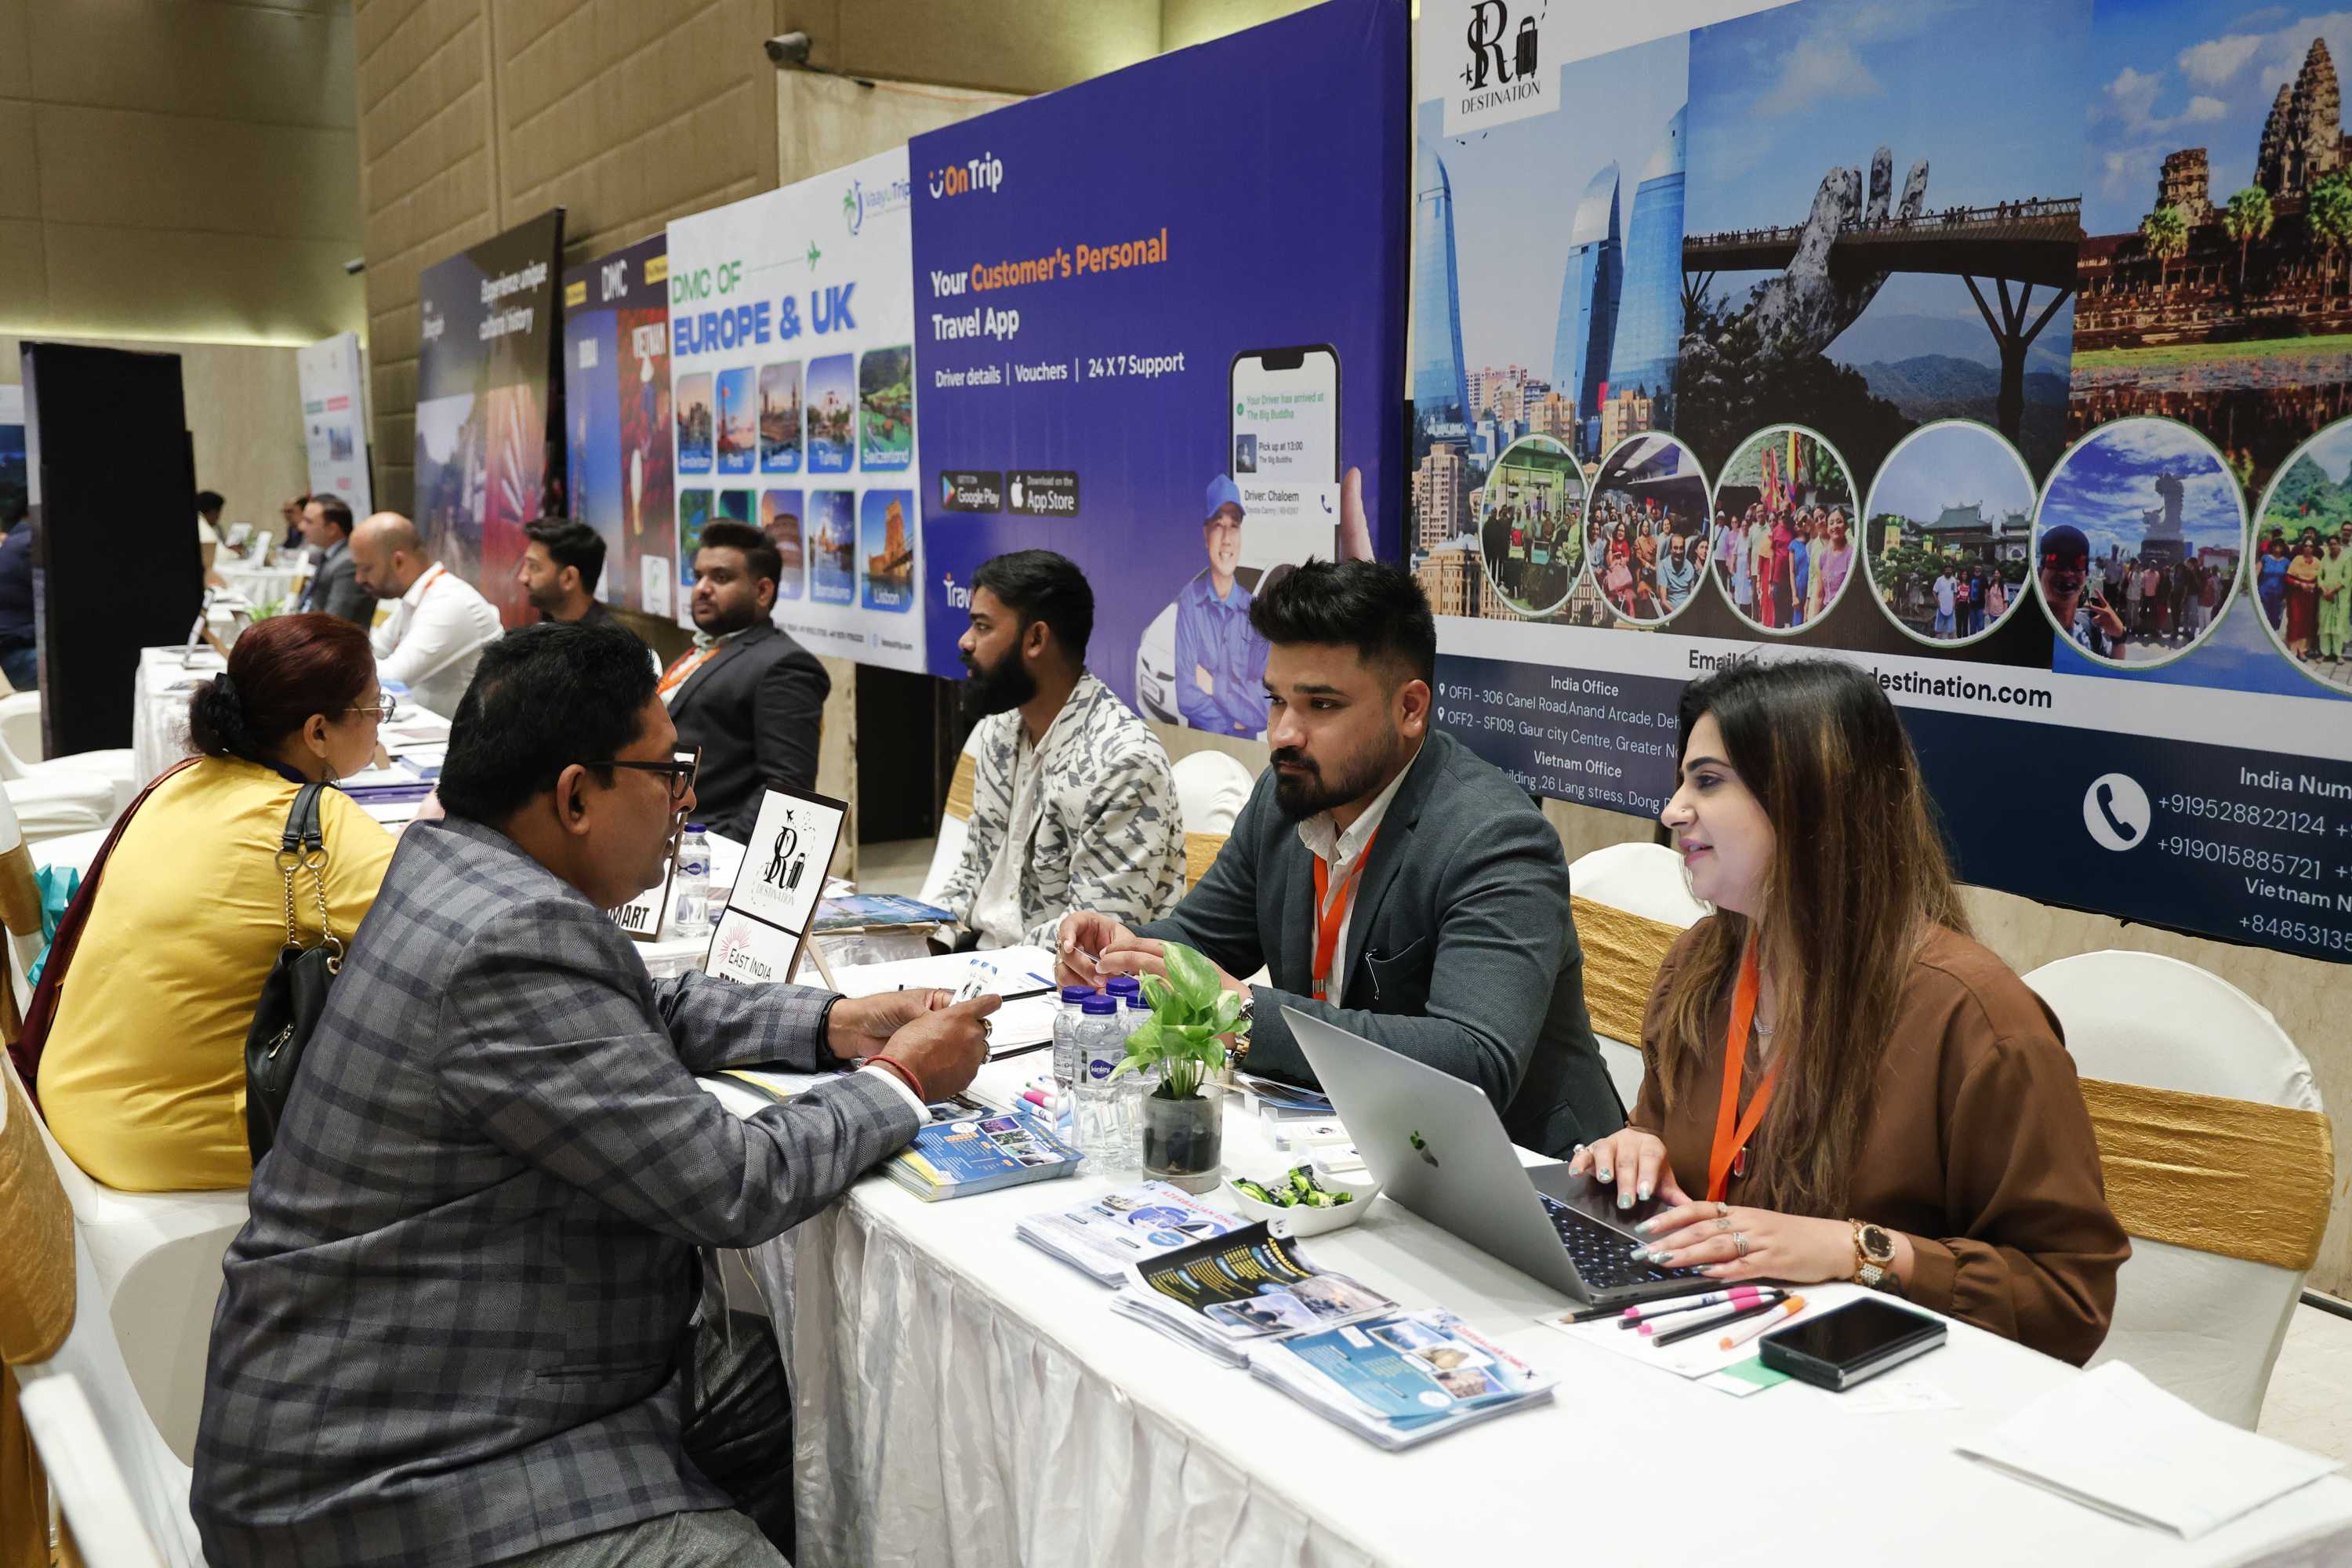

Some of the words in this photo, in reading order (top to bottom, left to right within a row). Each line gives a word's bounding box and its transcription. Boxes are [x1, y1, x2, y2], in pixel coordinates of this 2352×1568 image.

[1461, 81, 1541, 114] DESTINATION
[931, 270, 968, 298] Your
[971, 247, 1072, 292] Customer's
[1076, 227, 1167, 275] Personal
[672, 270, 712, 304] DMC
[717, 261, 742, 294] OF
[674, 301, 770, 356] EUROPE
[780, 296, 801, 340] &
[811, 281, 856, 335] UK
[932, 307, 980, 340] Travel
[984, 307, 1019, 341] App
[935, 368, 964, 388] Driver
[967, 365, 1001, 386] details
[1015, 361, 1067, 383] Vouchers
[1088, 358, 1105, 379] 24
[1106, 357, 1116, 376] X
[1118, 356, 1127, 375] 7
[1128, 352, 1185, 379] Support
[1247, 396, 1260, 405] Your
[1261, 394, 1279, 405] Driver
[1281, 394, 1292, 404] has
[1294, 393, 1316, 402] arrived
[1317, 392, 1324, 401] at
[1247, 410, 1258, 420] The
[1259, 410, 1269, 421] Big
[1271, 409, 1294, 419] Buddha
[818, 449, 843, 470] Turkey
[863, 447, 909, 465] Switzerland
[1258, 441, 1270, 451] Pick
[1272, 444, 1278, 452] up
[1279, 442, 1286, 451] at
[956, 487, 983, 508] Google
[983, 488, 1000, 508] Play
[1027, 490, 1047, 514] App
[1047, 490, 1075, 510] Store
[1244, 489, 1267, 502] Driver:
[874, 588, 901, 606] Lisbon
[1690, 649, 1737, 670] Email
[1551, 675, 1580, 692] India
[1583, 679, 1619, 697] Office
[1450, 685, 1472, 700] OFF1
[1483, 689, 1503, 705] 306
[1506, 692, 1536, 710] Canel
[1609, 706, 1653, 728] Arcade,
[1447, 710, 1473, 728] OFF2
[1519, 721, 1543, 738] Gaur
[1548, 726, 1568, 745] city
[1570, 729, 1613, 750] Centre,
[1616, 736, 1662, 757] Greater
[1534, 750, 1582, 771] Vietnam
[1585, 759, 1622, 778] Office
[1559, 778, 1584, 800] Lang
[1588, 786, 1625, 806] stress,
[1628, 791, 1660, 814] Dong
[2240, 767, 2293, 792] India
[2299, 774, 2352, 800] Num
[2158, 793, 2326, 836] +919528822124
[2158, 836, 2321, 880] +919015885721
[757, 883, 795, 906] DESTINATION
[2245, 876, 2331, 909] Vietnam
[728, 948, 750, 969] EAST
[750, 950, 771, 981] INDIA
